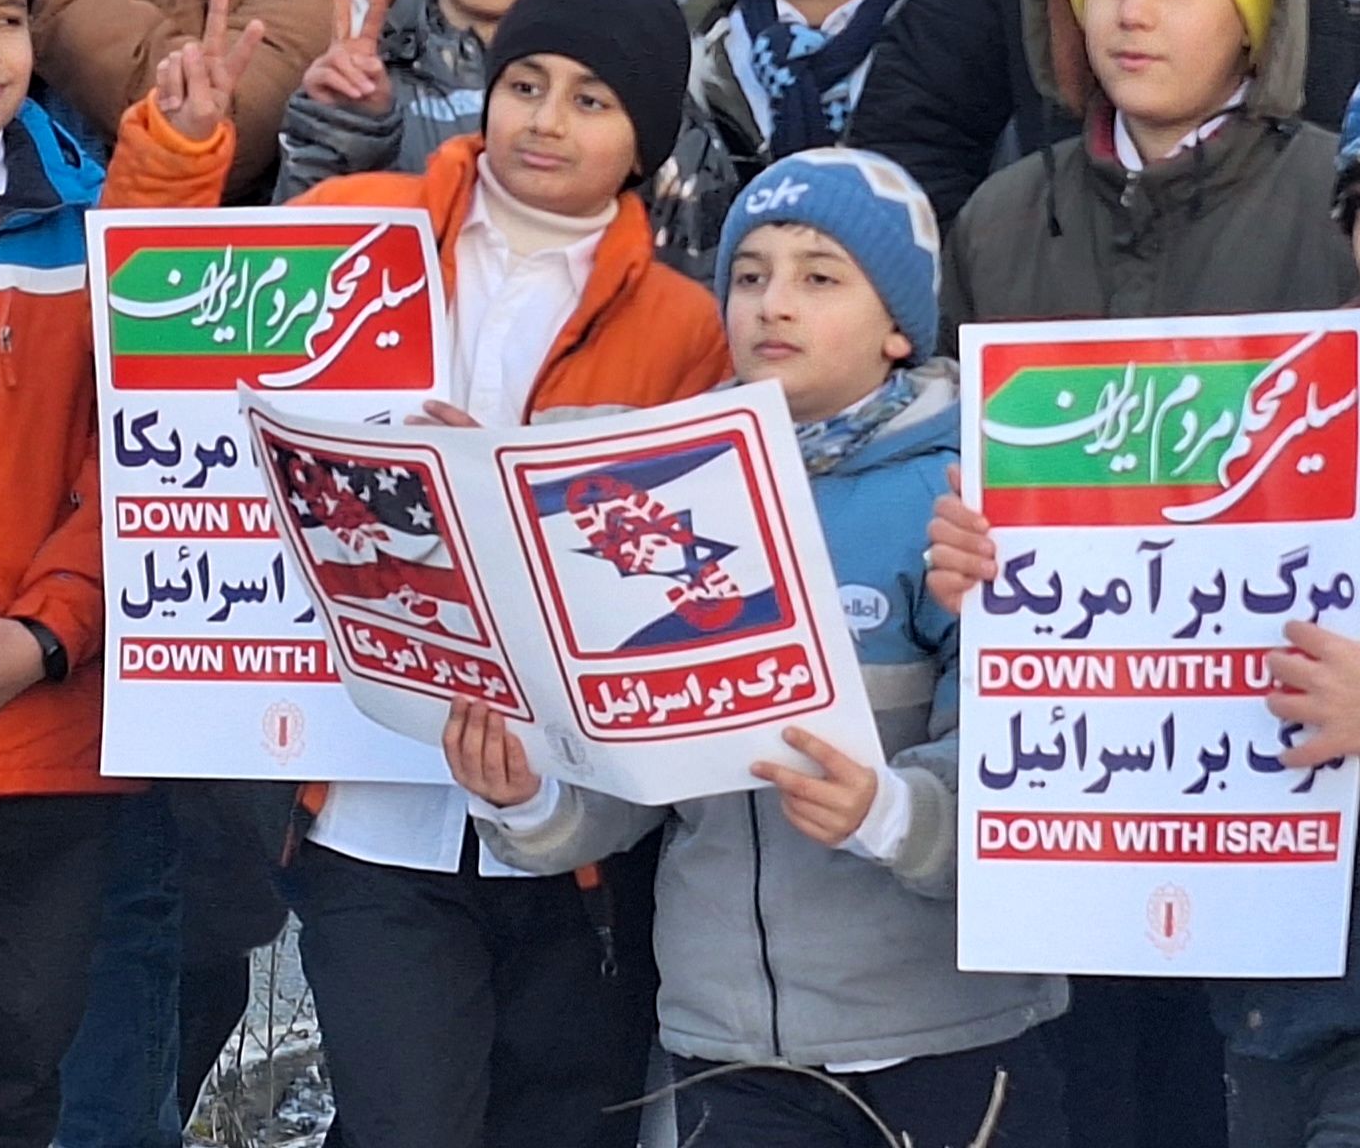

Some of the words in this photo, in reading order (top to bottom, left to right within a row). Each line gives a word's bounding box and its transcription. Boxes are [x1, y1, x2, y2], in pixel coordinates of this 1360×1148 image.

[109, 245, 249, 342] ایران
[247, 257, 317, 353] مردم
[258, 268, 426, 387] سیلی
[304, 222, 389, 358] محکم
[112, 408, 258, 488] مریکا
[982, 360, 1155, 472] ایران
[1149, 374, 1234, 484] مردم
[1218, 332, 1326, 489] محکم
[1161, 382, 1357, 522] سیلی
[119, 502, 229, 532] DOWN
[120, 545, 286, 622] اسرائیل
[981, 538, 1175, 639] آمریکا
[1171, 568, 1227, 639] بر
[122, 643, 223, 672] DOWN
[232, 645, 316, 674] WITH
[704, 677, 734, 716] بر
[738, 656, 810, 702] مرگ
[980, 654, 1115, 690] DOWN
[1128, 654, 1232, 689] WITH
[588, 673, 702, 725] اسرائیل
[978, 705, 1175, 794] اسرائیل
[1182, 732, 1231, 794] بر
[980, 817, 1102, 852] DOWN
[1112, 820, 1206, 852] WITH
[1216, 820, 1336, 853] ISRAEL
